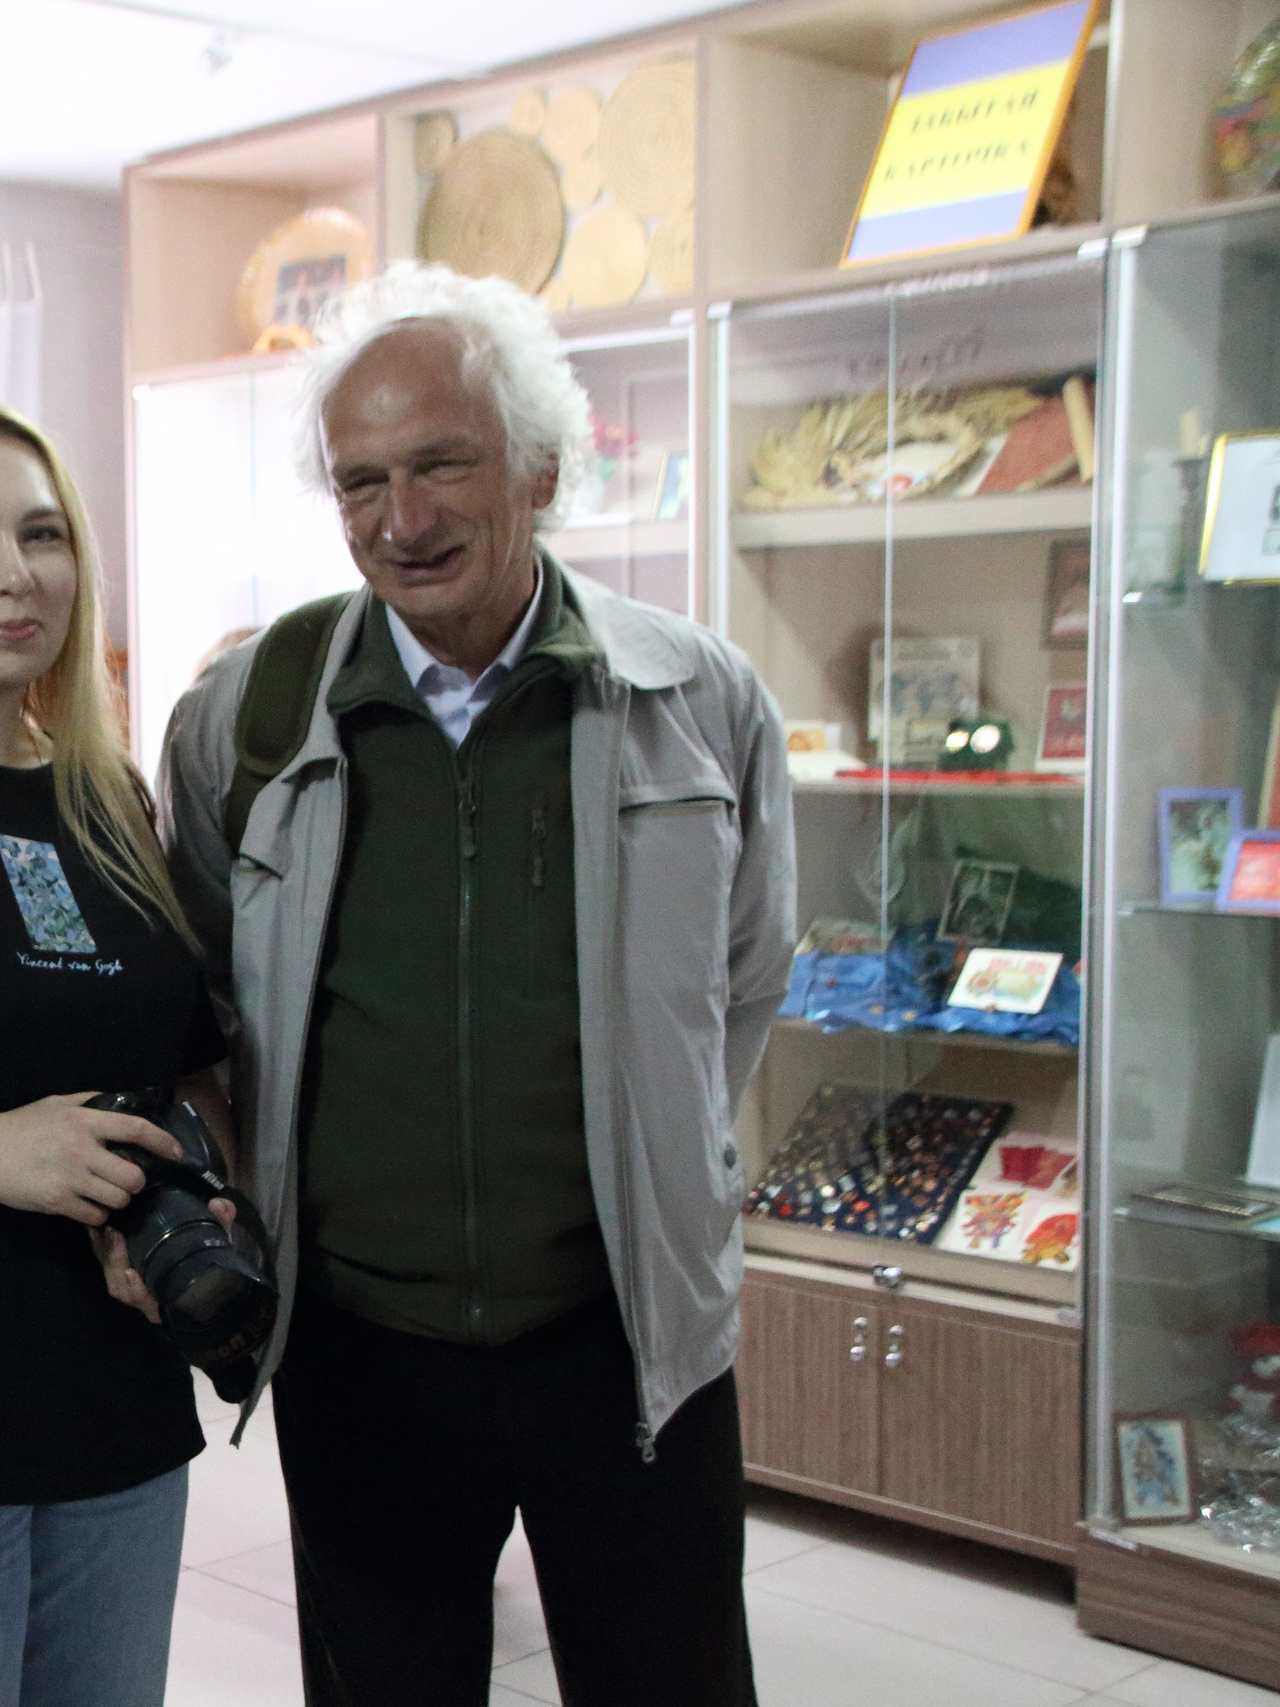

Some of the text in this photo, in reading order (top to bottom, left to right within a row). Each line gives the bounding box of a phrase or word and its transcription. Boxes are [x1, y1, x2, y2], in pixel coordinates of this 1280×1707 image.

[16, 951, 124, 976] Vincent van Gogh
[201, 1170, 225, 1191] Nikon
